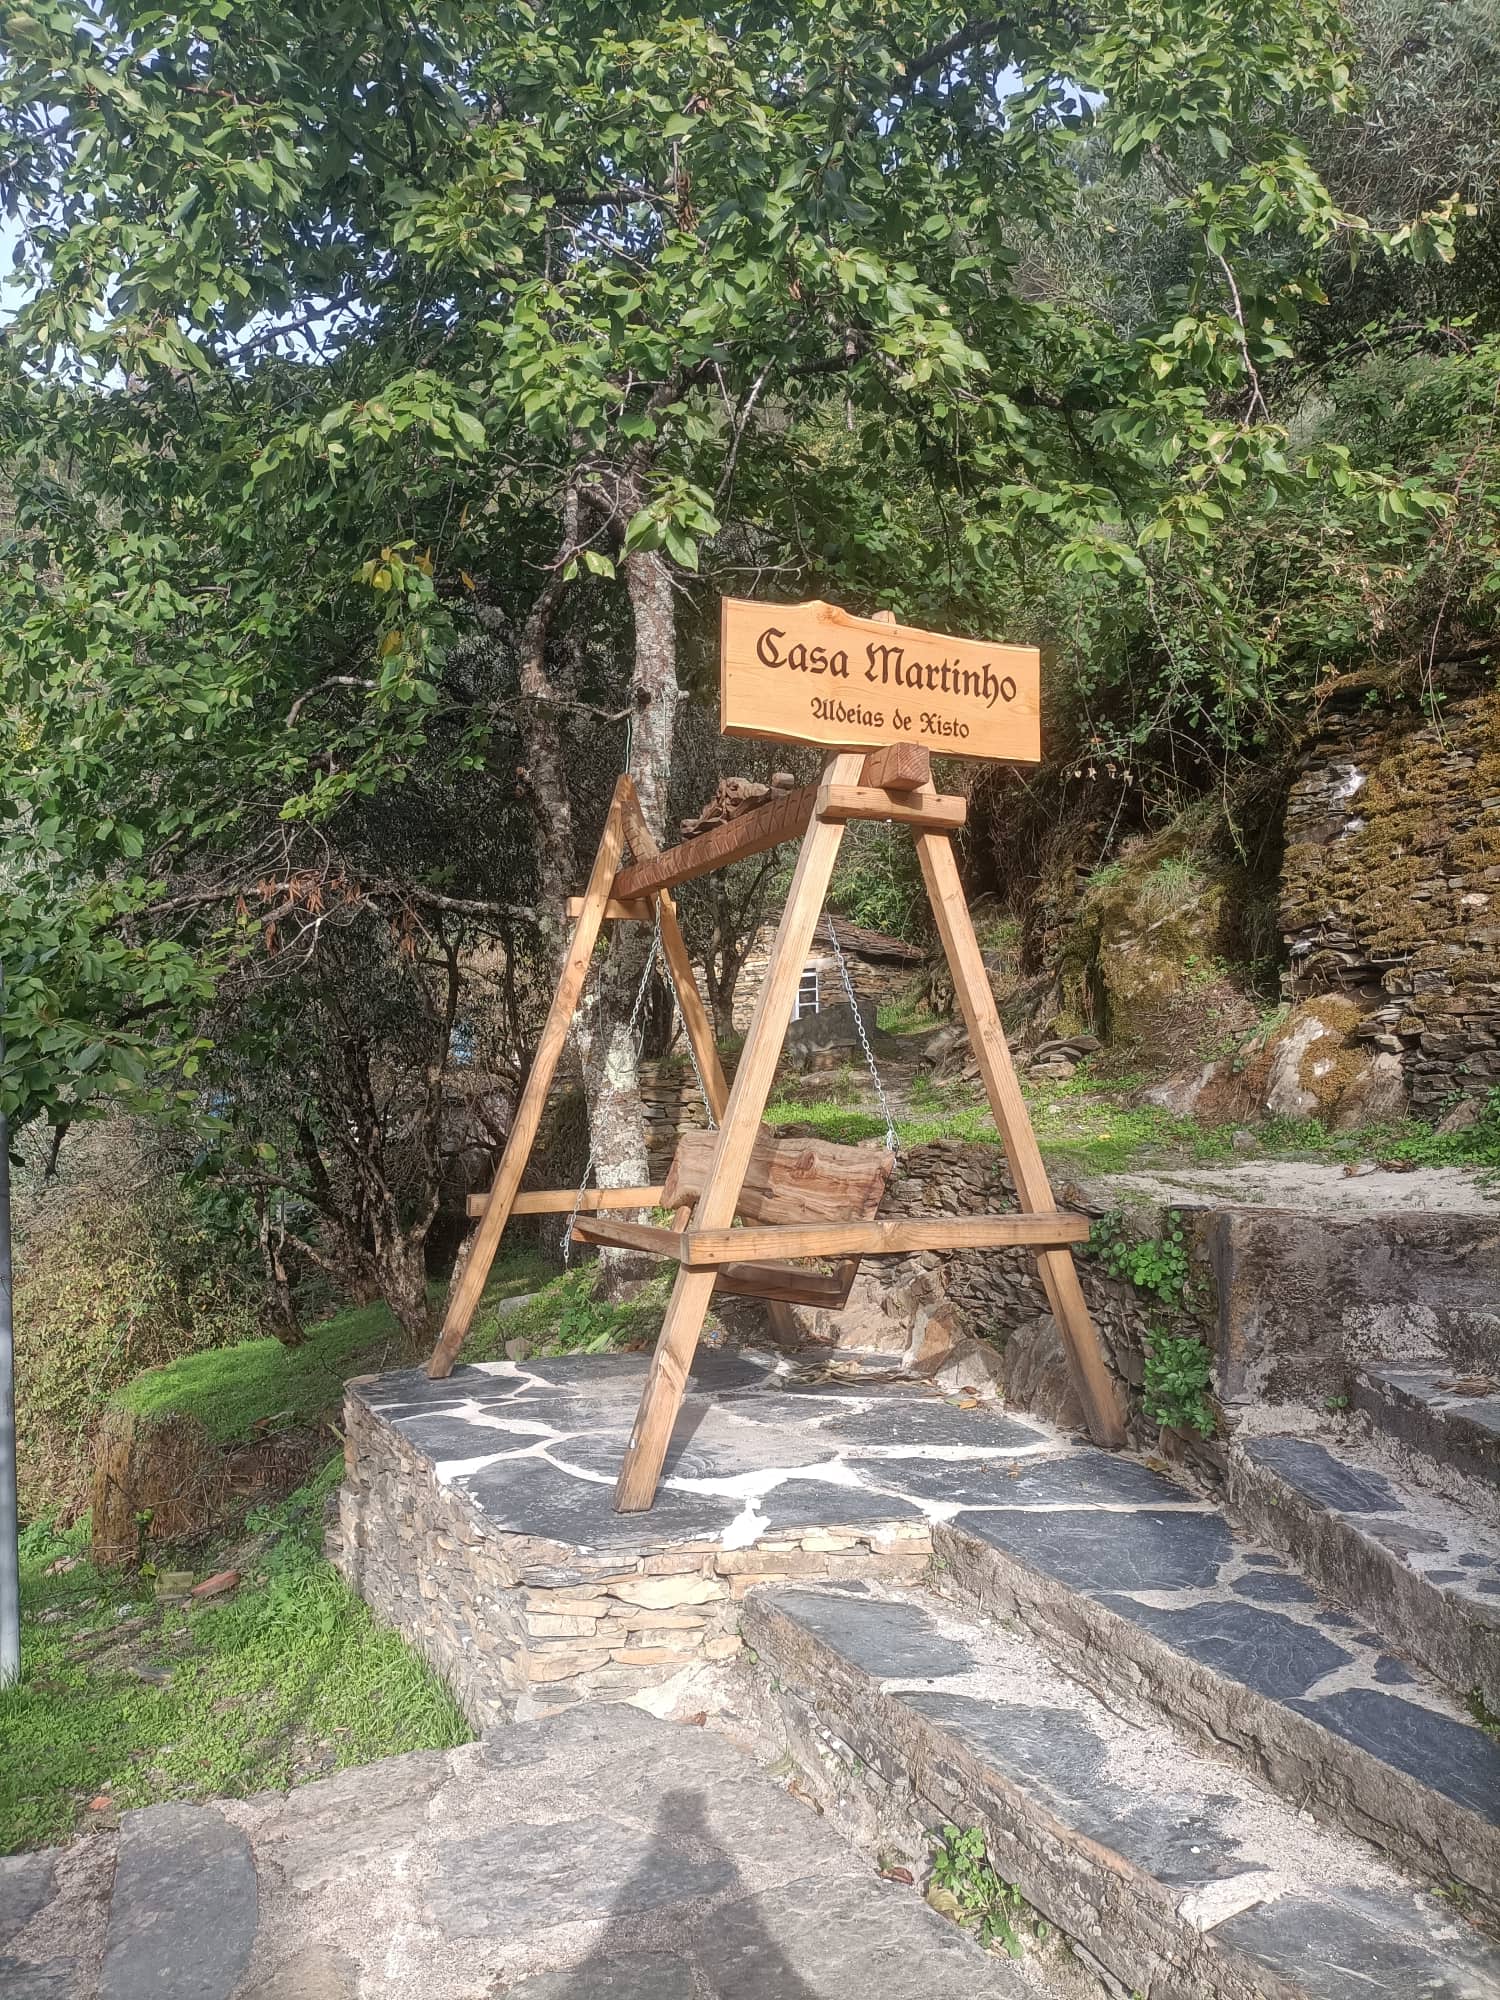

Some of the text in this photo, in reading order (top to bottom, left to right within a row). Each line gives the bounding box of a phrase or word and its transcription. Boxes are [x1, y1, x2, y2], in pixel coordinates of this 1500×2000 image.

[756, 627, 1017, 709] Casa Martinho
[810, 697, 970, 738] Aldeias de Xisto
